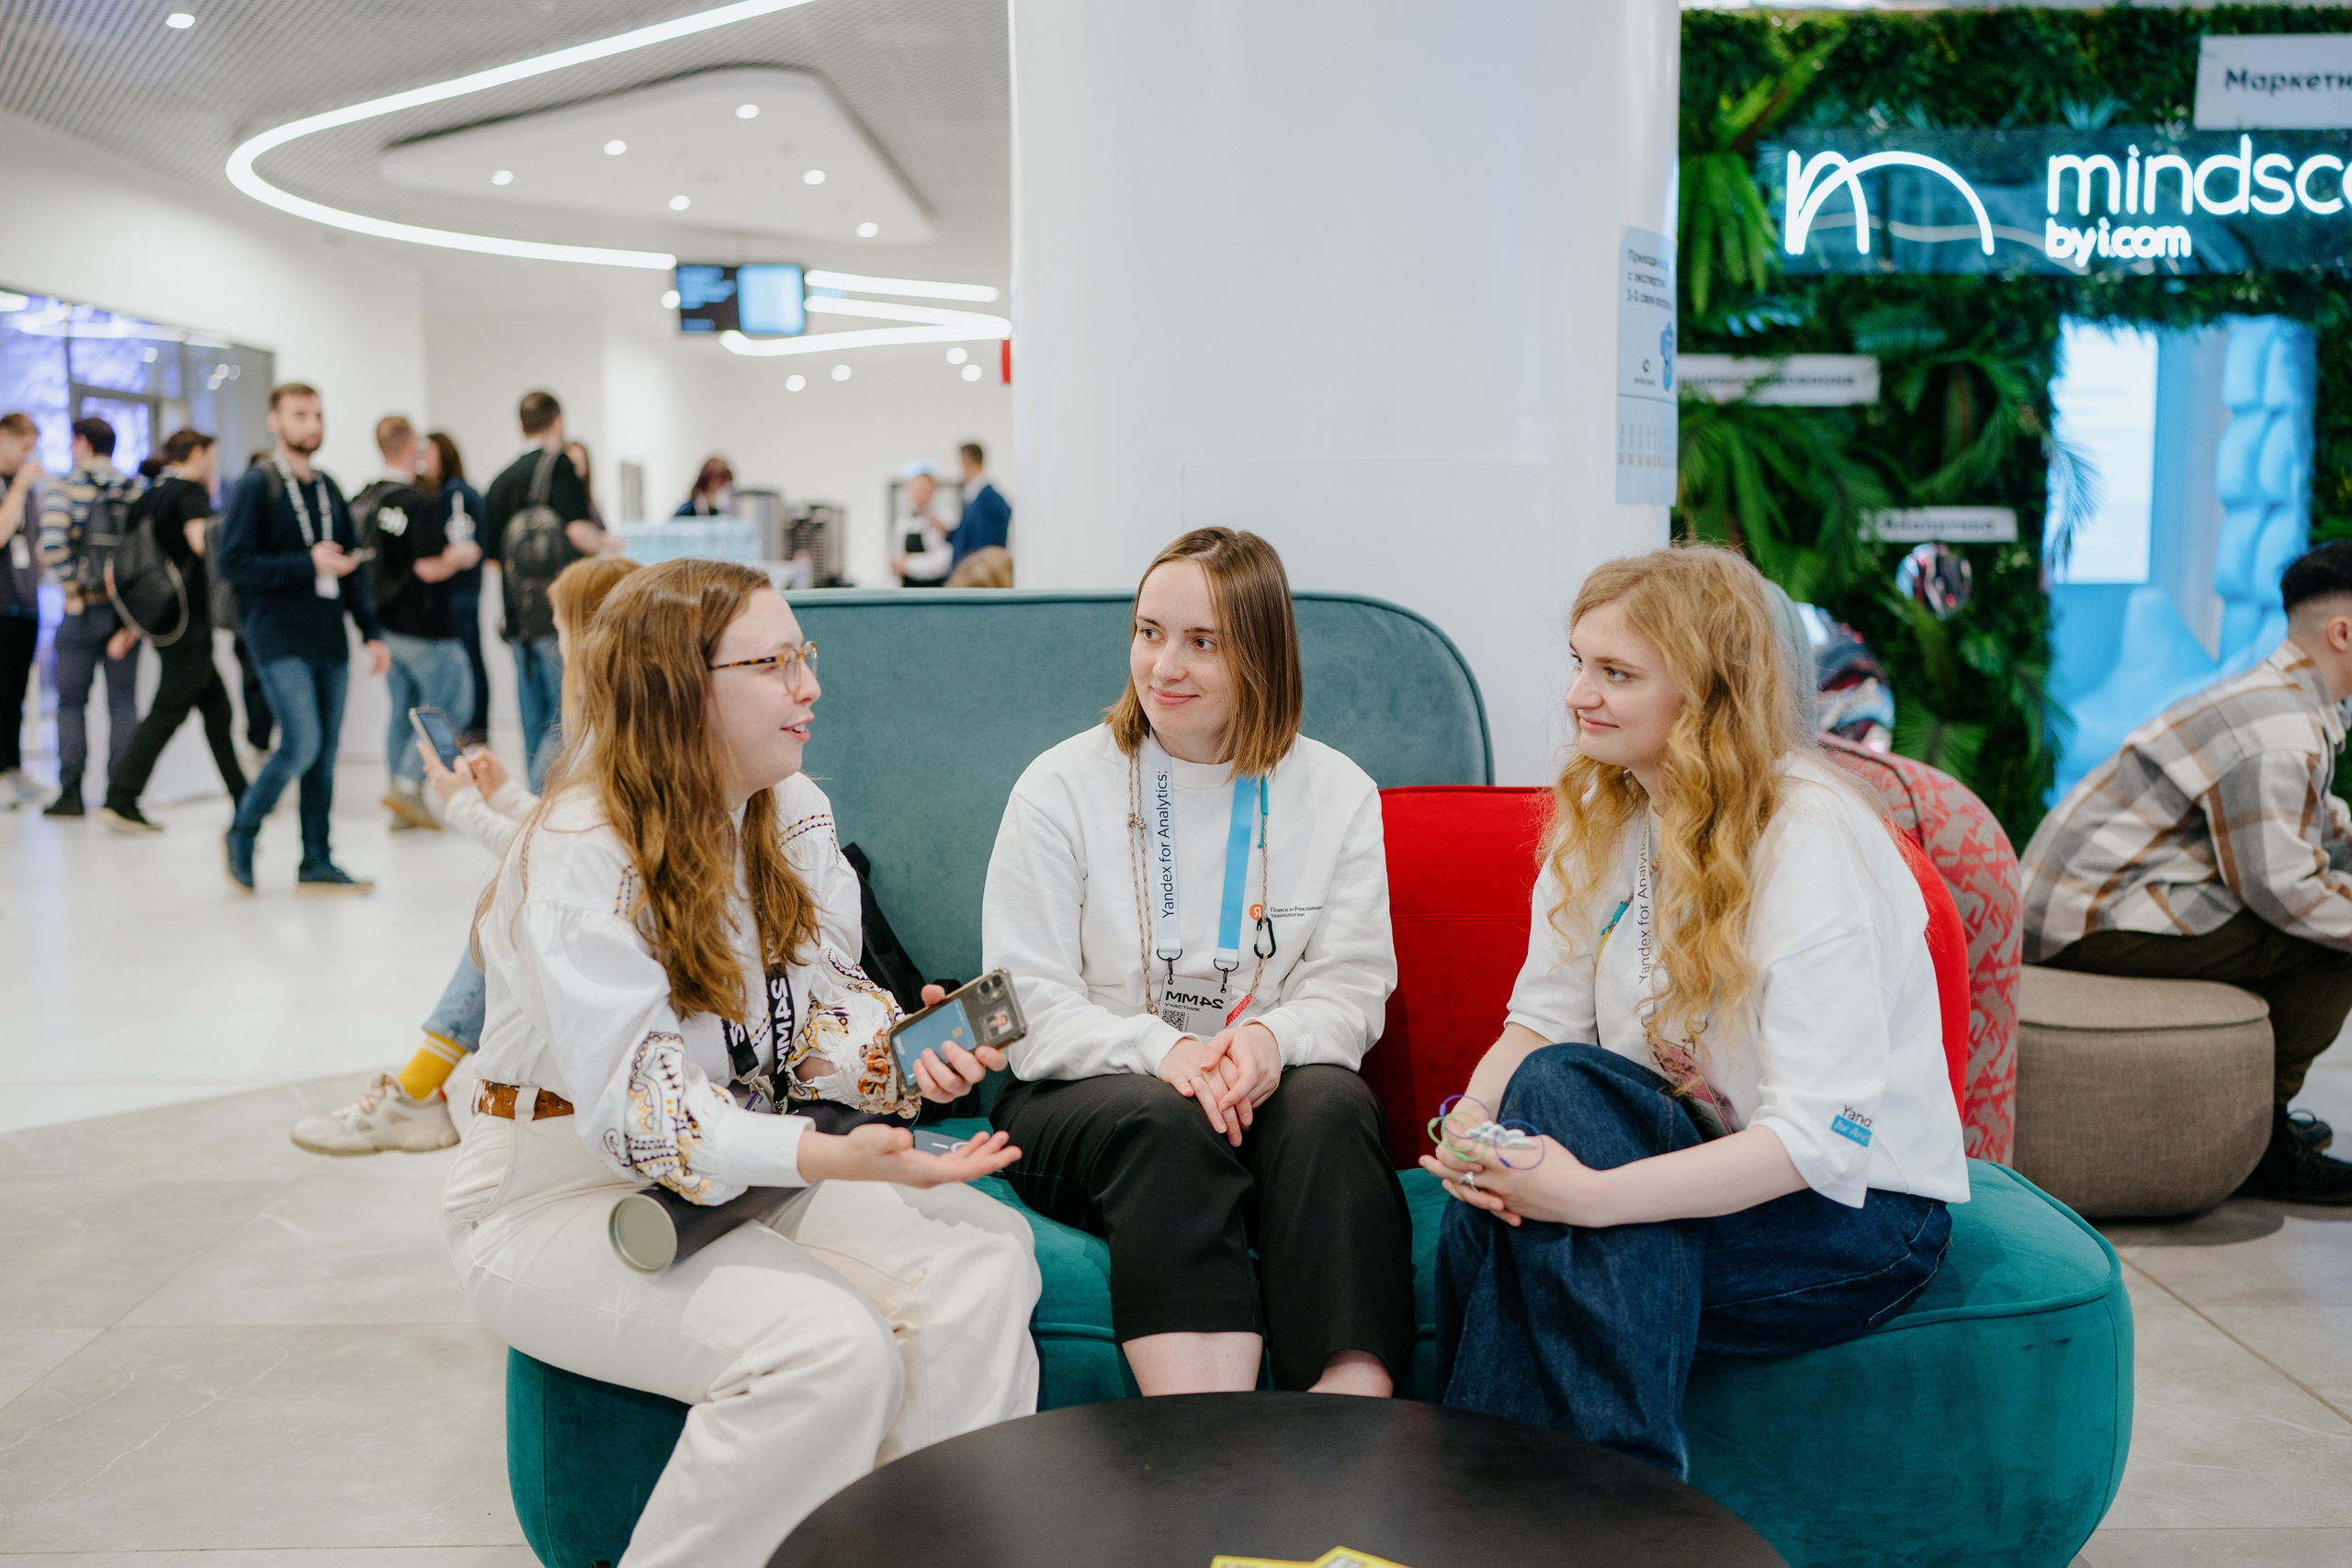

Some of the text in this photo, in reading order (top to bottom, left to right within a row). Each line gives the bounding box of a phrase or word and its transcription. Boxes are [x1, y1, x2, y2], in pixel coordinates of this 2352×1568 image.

[2047, 133, 2352, 215] mindsc
[1159, 842, 1171, 863] for
[1160, 866, 1174, 919] Yandex
[1638, 905, 1649, 925] for
[1638, 931, 1651, 985] Yandex
[1164, 1002, 1201, 1012] УЧАСТНИК
